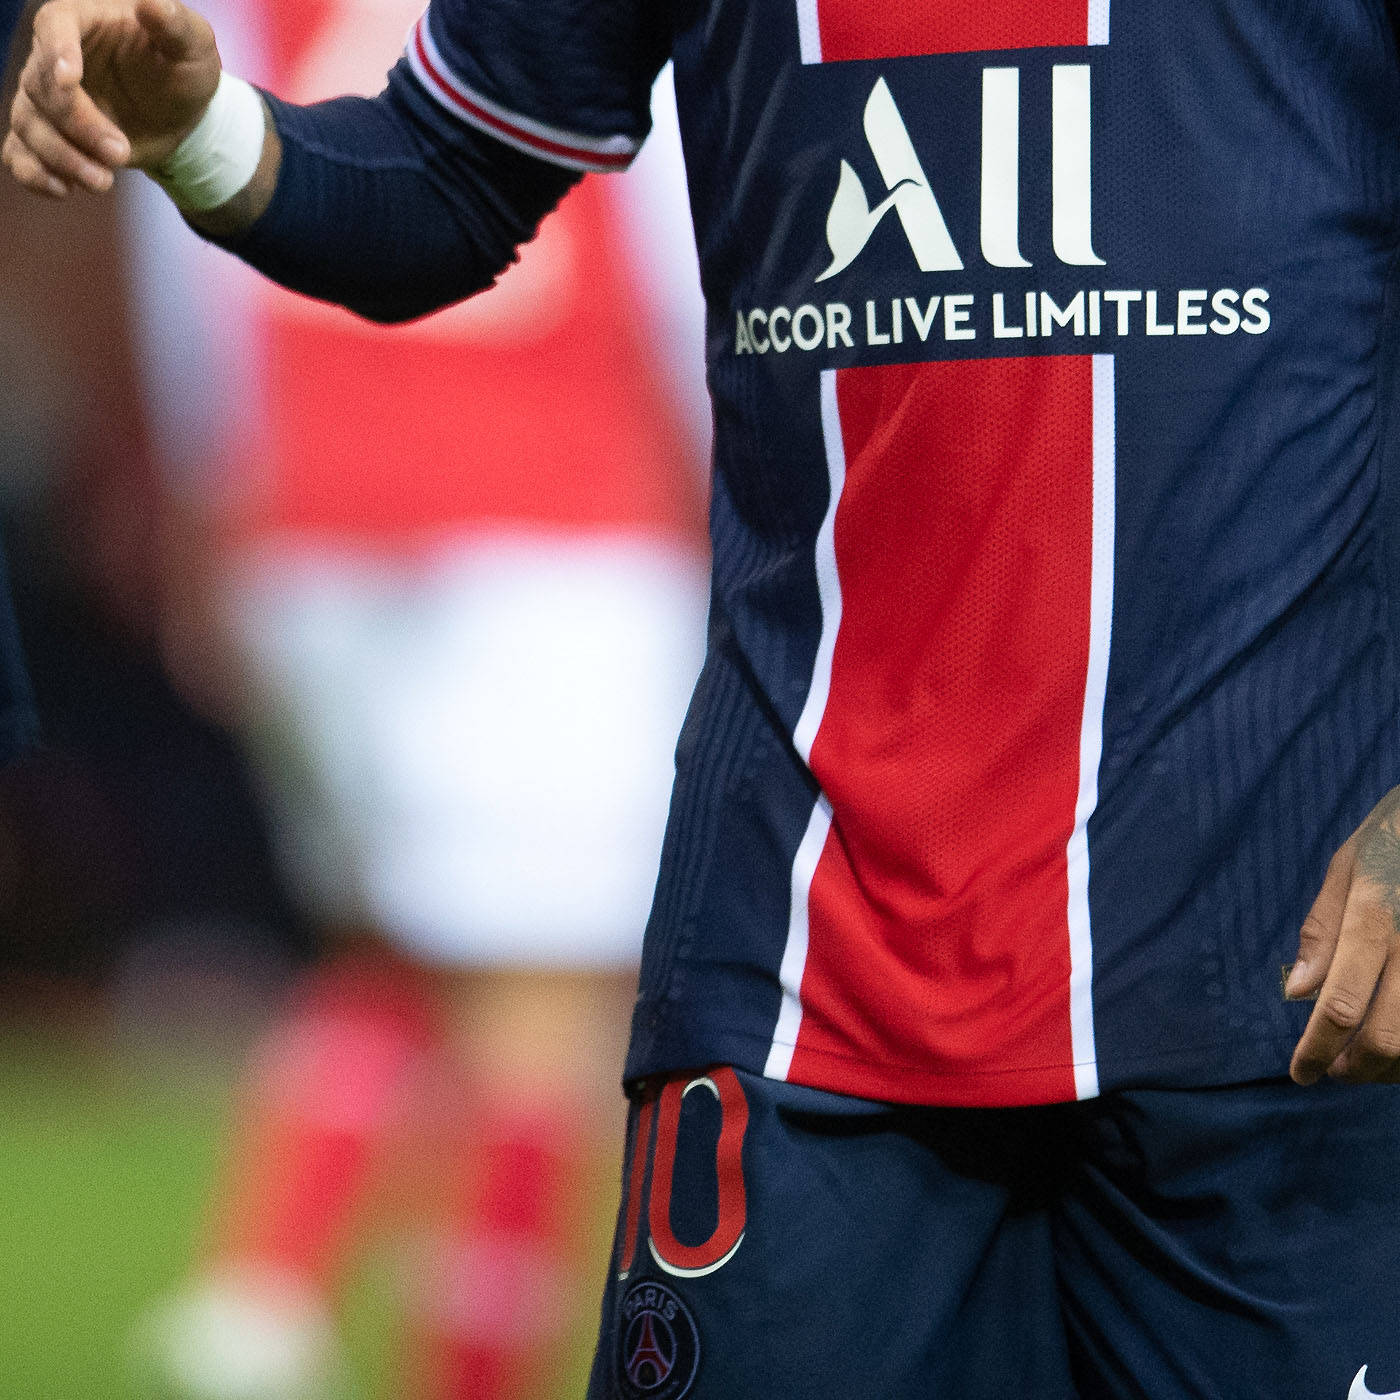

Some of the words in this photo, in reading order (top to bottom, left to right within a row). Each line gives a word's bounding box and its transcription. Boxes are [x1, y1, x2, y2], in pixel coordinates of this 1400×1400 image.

[735, 302, 855, 355] ACCOR
[865, 294, 977, 346] LIVE
[992, 287, 1271, 339] LIMITLESS
